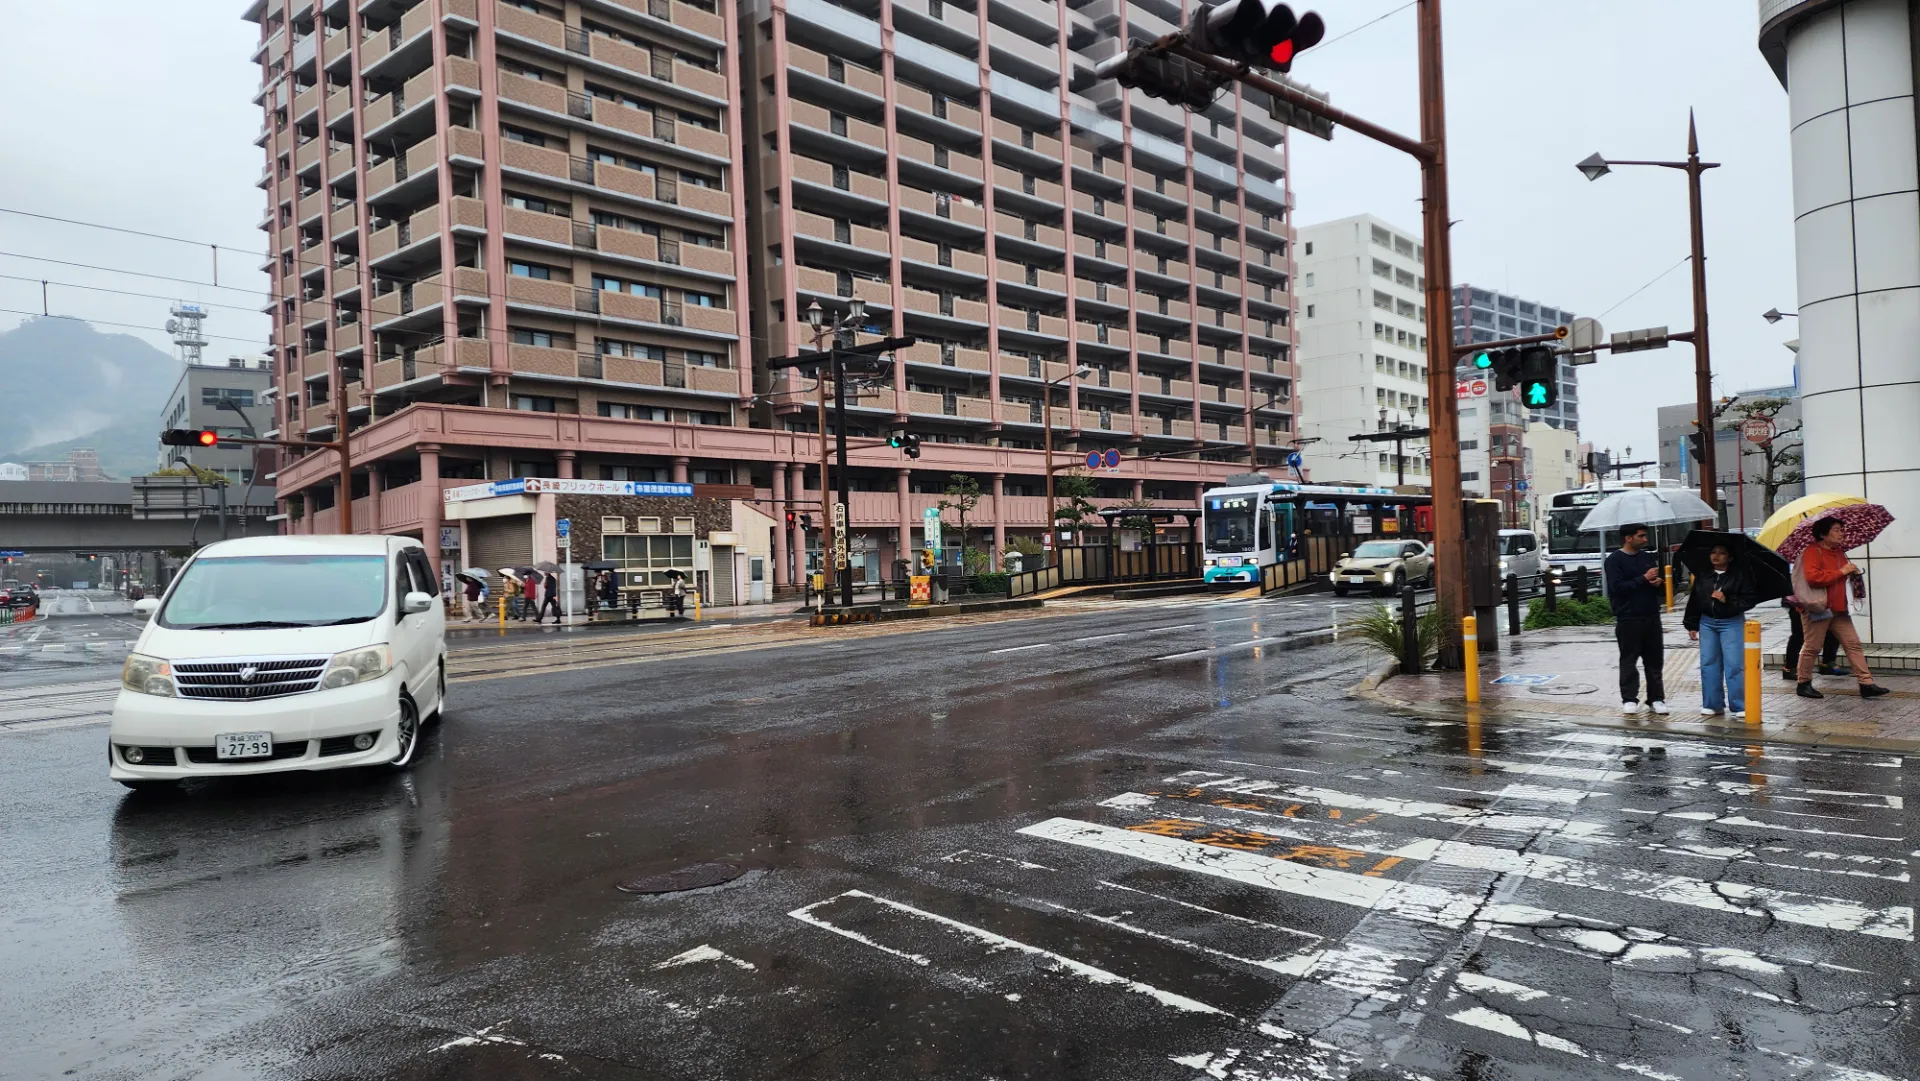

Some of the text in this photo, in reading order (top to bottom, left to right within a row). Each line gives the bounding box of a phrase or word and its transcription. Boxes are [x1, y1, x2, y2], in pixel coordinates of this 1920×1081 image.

[1746, 427, 1769, 436] 消火栓
[229, 742, 268, 756] 27-99
